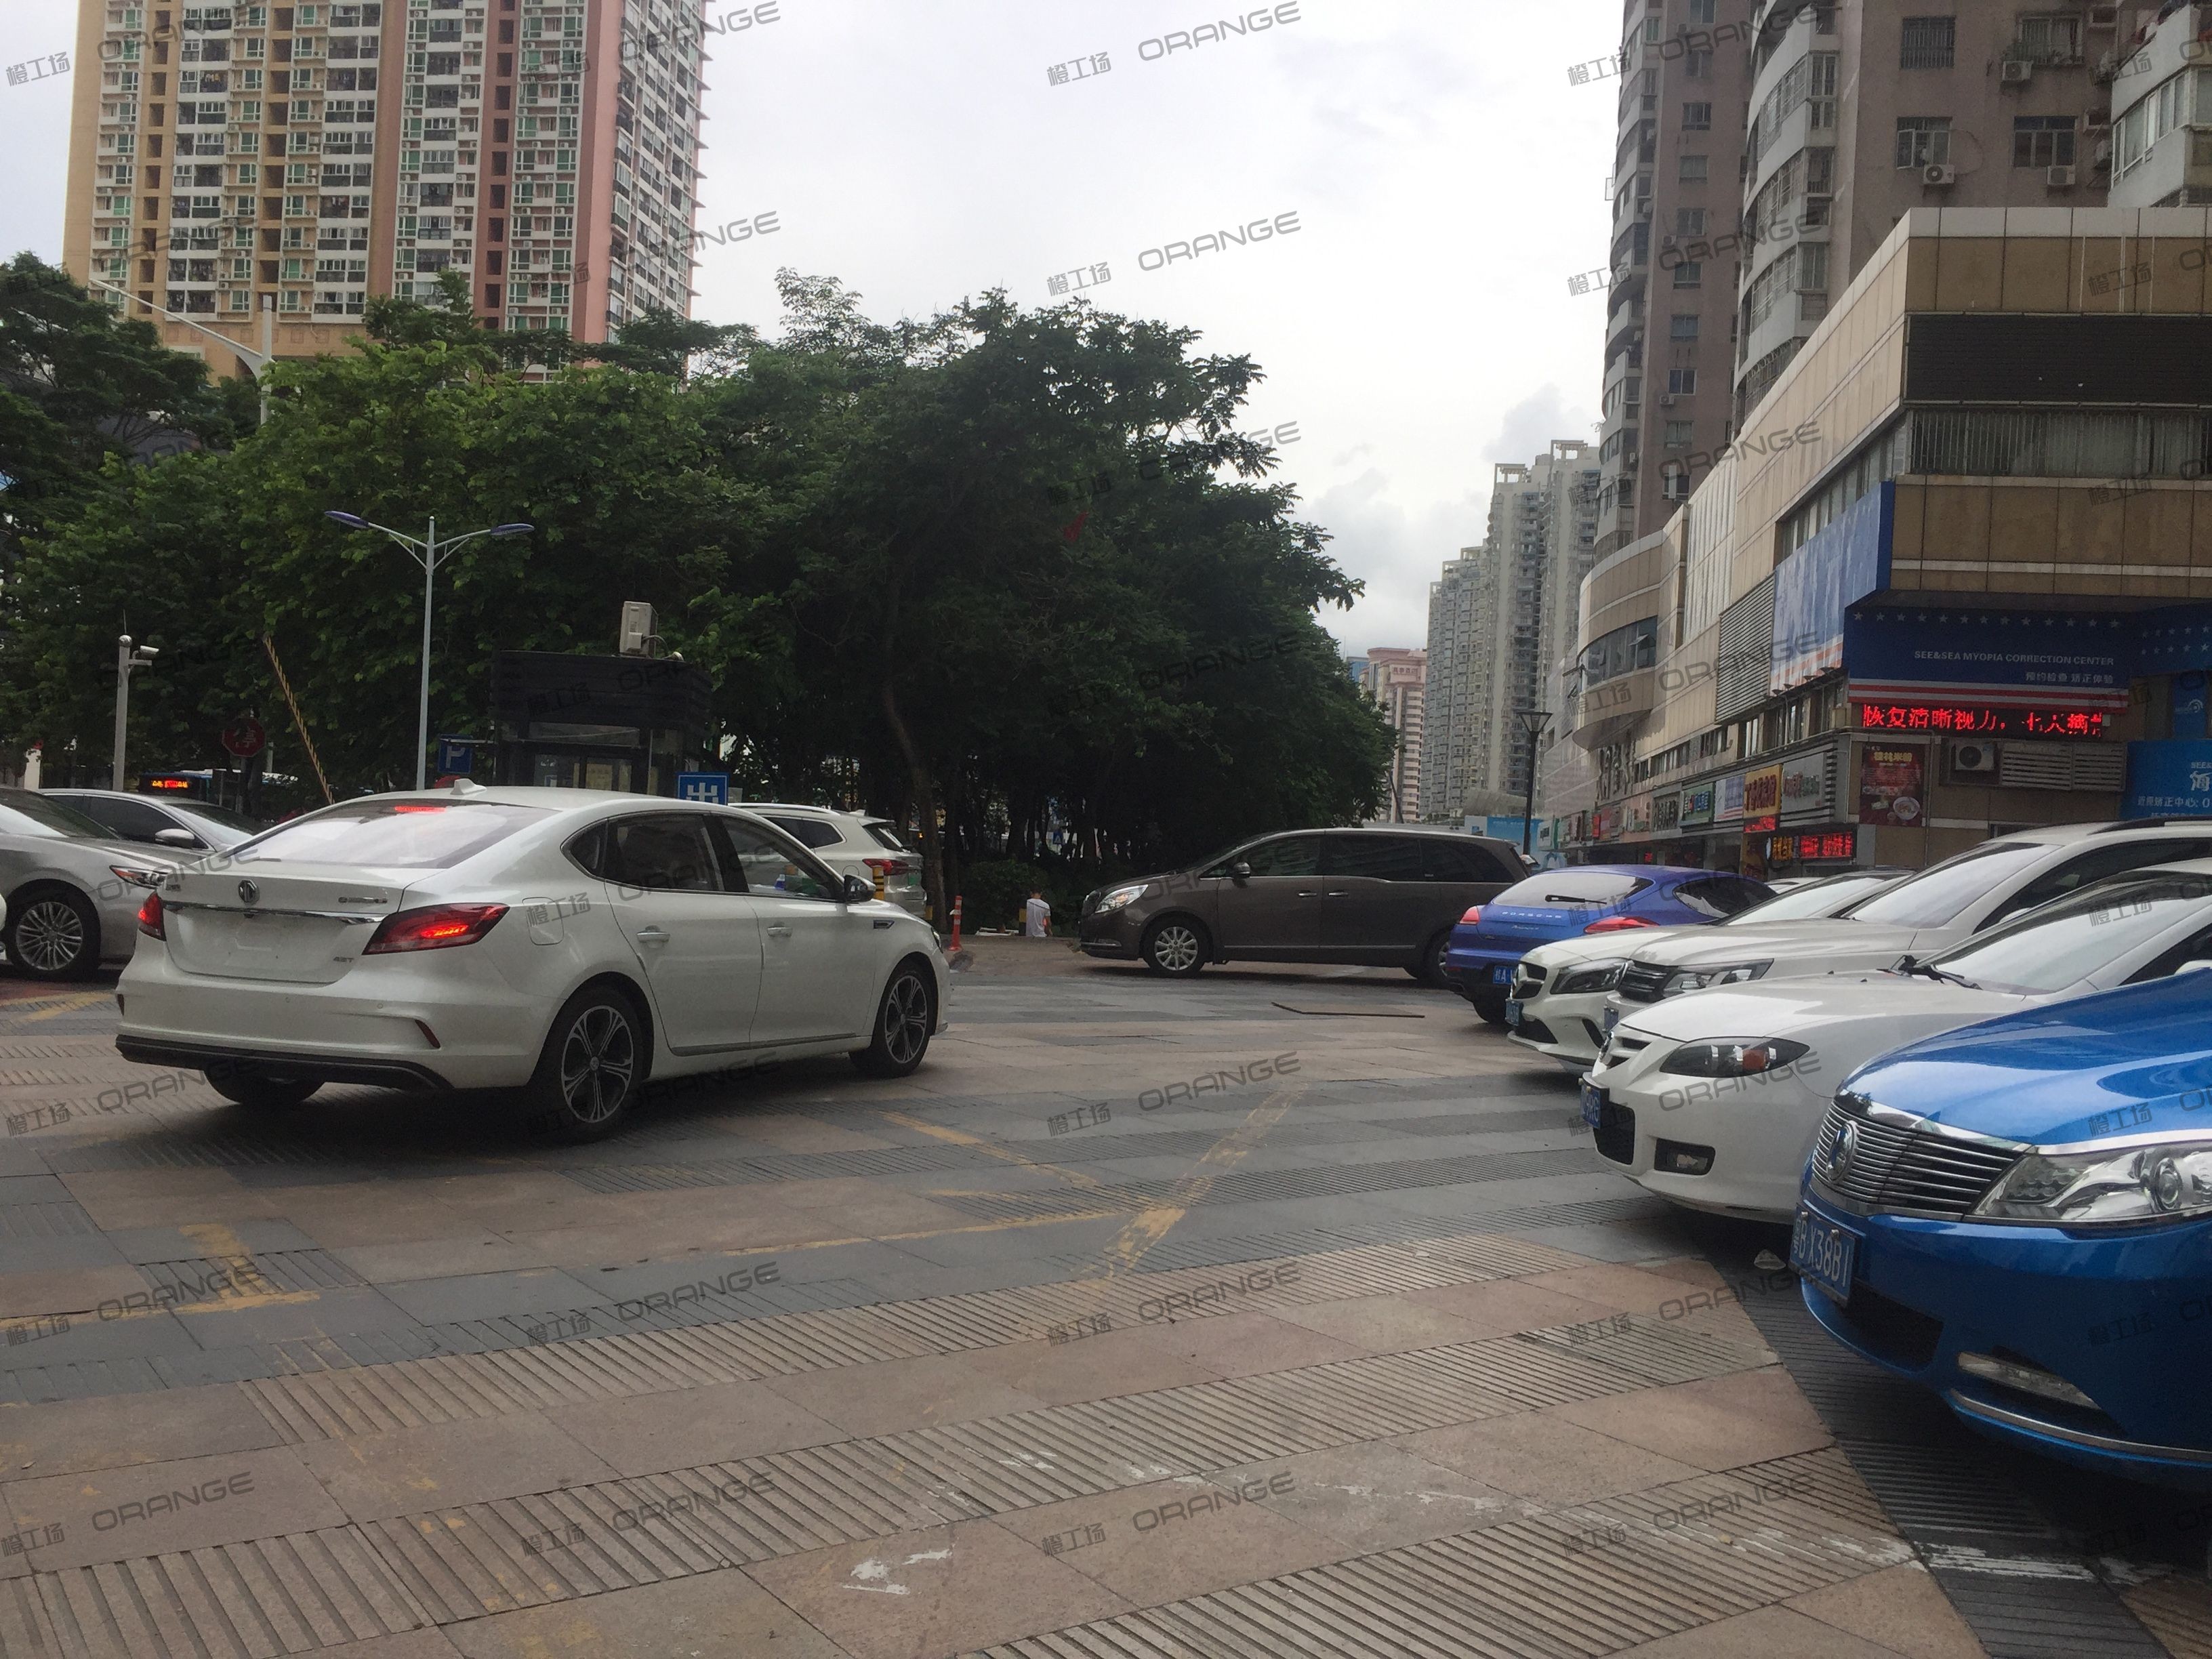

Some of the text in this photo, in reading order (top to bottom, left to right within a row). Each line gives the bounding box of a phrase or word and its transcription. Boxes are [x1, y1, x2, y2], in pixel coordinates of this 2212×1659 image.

[1914, 651, 2114, 666] SEE&SEA MYOPIA CORRECTION CENTER
